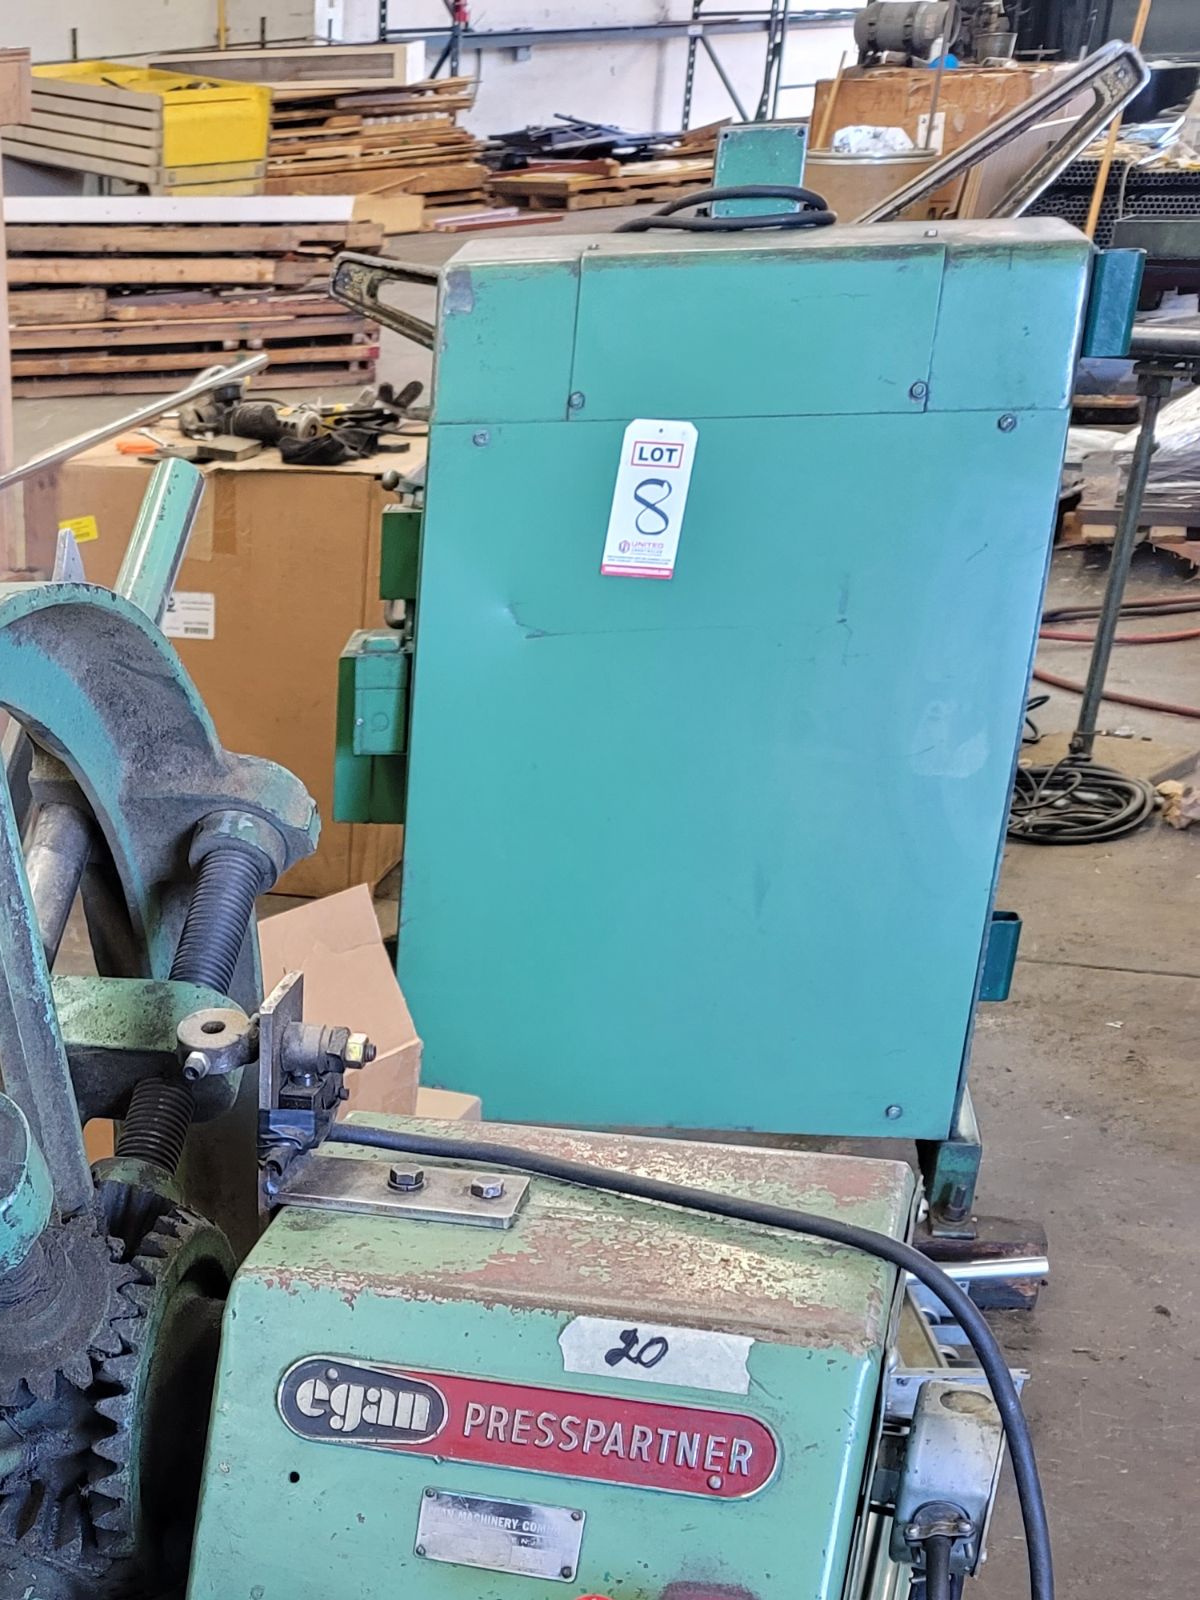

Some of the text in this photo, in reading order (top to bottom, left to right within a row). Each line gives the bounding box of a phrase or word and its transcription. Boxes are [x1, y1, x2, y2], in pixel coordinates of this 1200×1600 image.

[638, 446, 678, 463] LOT
[633, 478, 672, 535] 8
[604, 1327, 669, 1369] 20
[462, 1401, 755, 1477] PRESSPARTNER
[458, 1510, 519, 1530] MACHINERY
